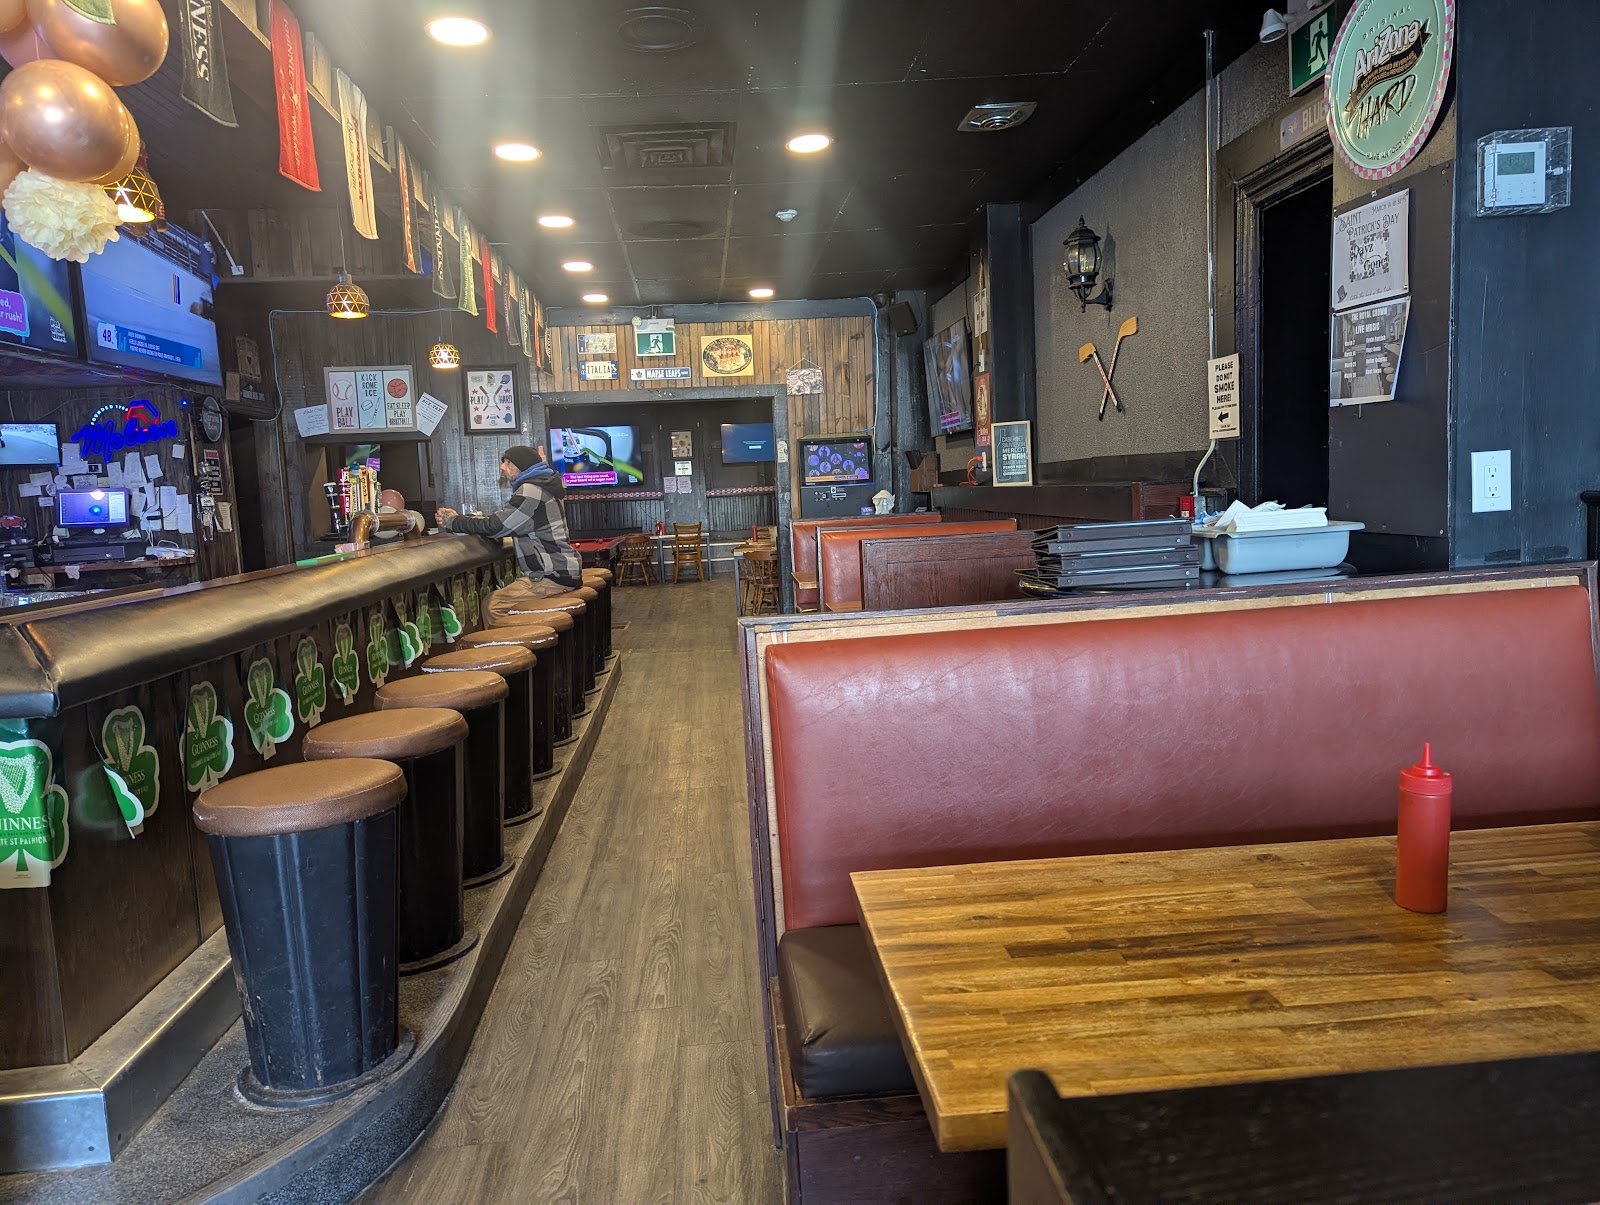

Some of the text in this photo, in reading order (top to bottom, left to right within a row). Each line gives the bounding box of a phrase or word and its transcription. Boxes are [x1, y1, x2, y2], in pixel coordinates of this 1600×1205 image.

[1363, 4, 1411, 39] ORIGINAL
[1356, 75, 1416, 140] HARD
[1336, 211, 1362, 234] SAINT
[1347, 213, 1399, 241] PATRICK'S DAY
[1355, 322, 1380, 334] LIVE MUSIC
[102, 329, 112, 342] 48
[1215, 361, 1234, 372] PLEASE
[361, 373, 377, 381] KICK
[646, 370, 664, 379] MAPLE
[665, 369, 681, 378] LEAFS
[1216, 372, 1233, 382] DO NOT
[1214, 381, 1235, 393] SMOKE
[1216, 394, 1232, 404] HERE!
[90, 404, 114, 426] FOUNDED
[336, 407, 353, 418] PLAY
[191, 736, 219, 756] GUINNESS
[10, 838, 18, 846] ST
